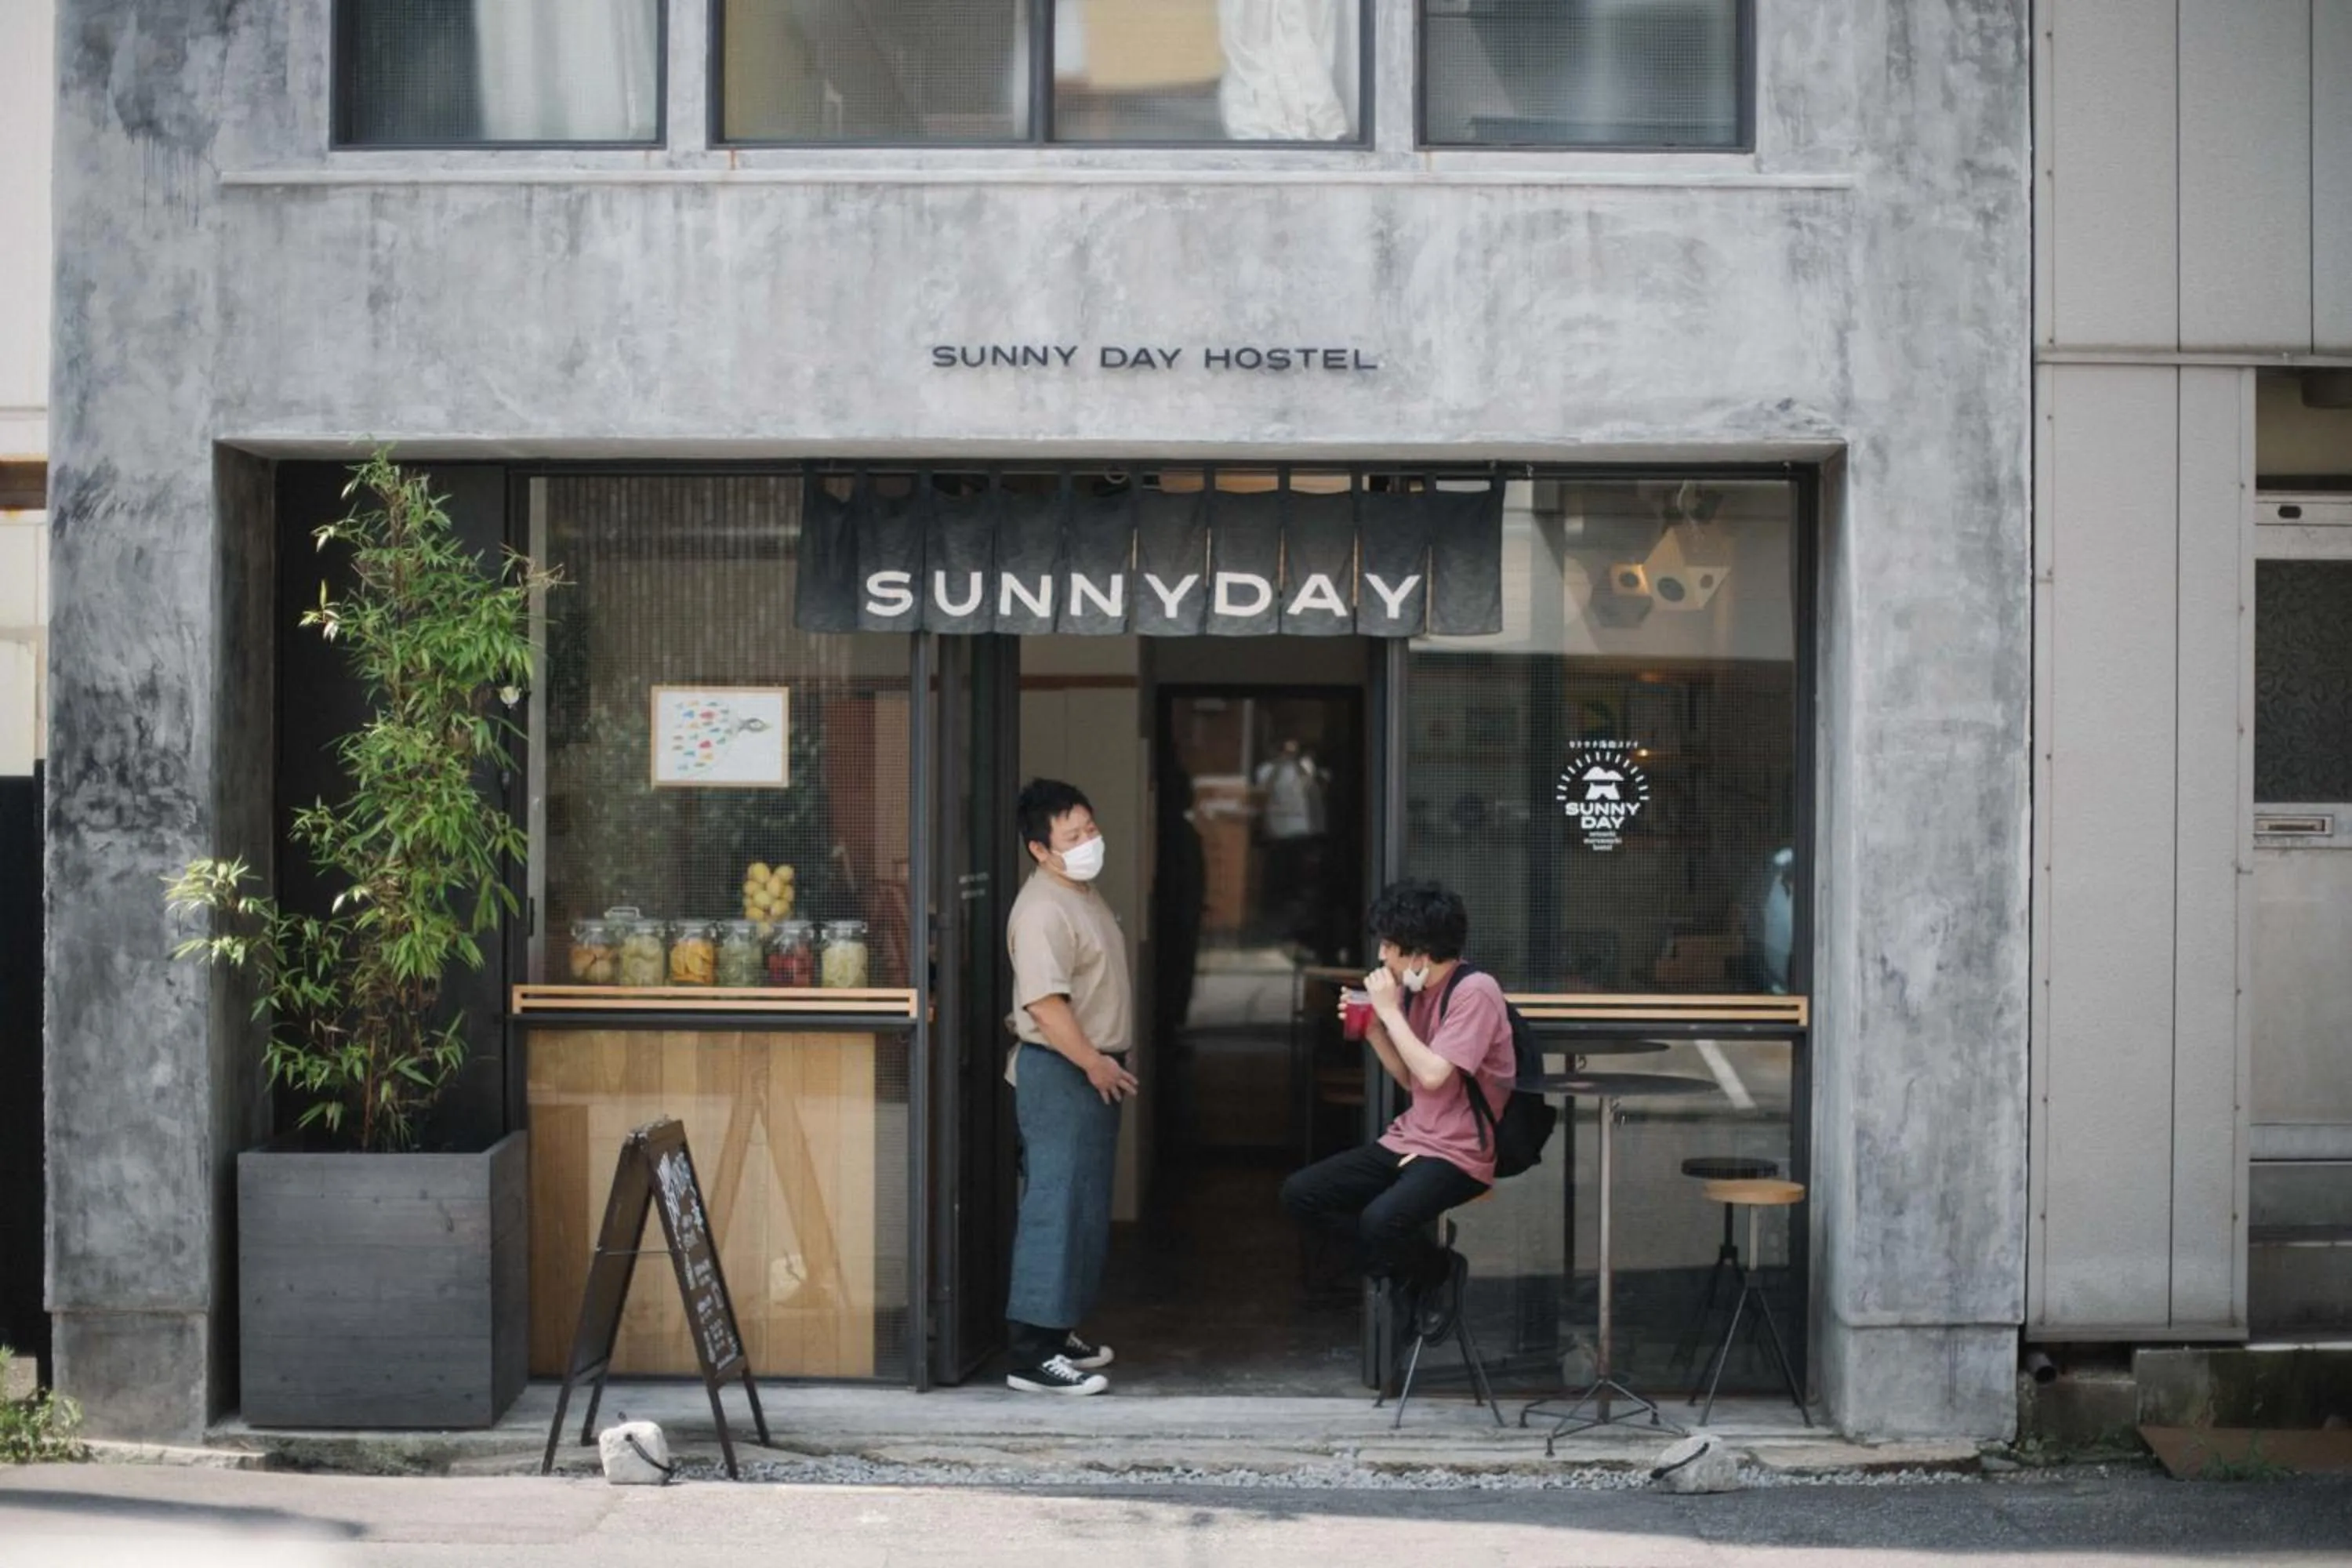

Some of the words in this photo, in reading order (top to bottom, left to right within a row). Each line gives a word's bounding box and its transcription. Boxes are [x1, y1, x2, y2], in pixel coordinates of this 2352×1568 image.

[932, 345, 1078, 368] SUNNY
[1099, 347, 1182, 370] DAY
[1204, 348, 1378, 372] HOSTEL
[1565, 802, 1641, 816] SUNNY
[1581, 816, 1625, 829] DAY
